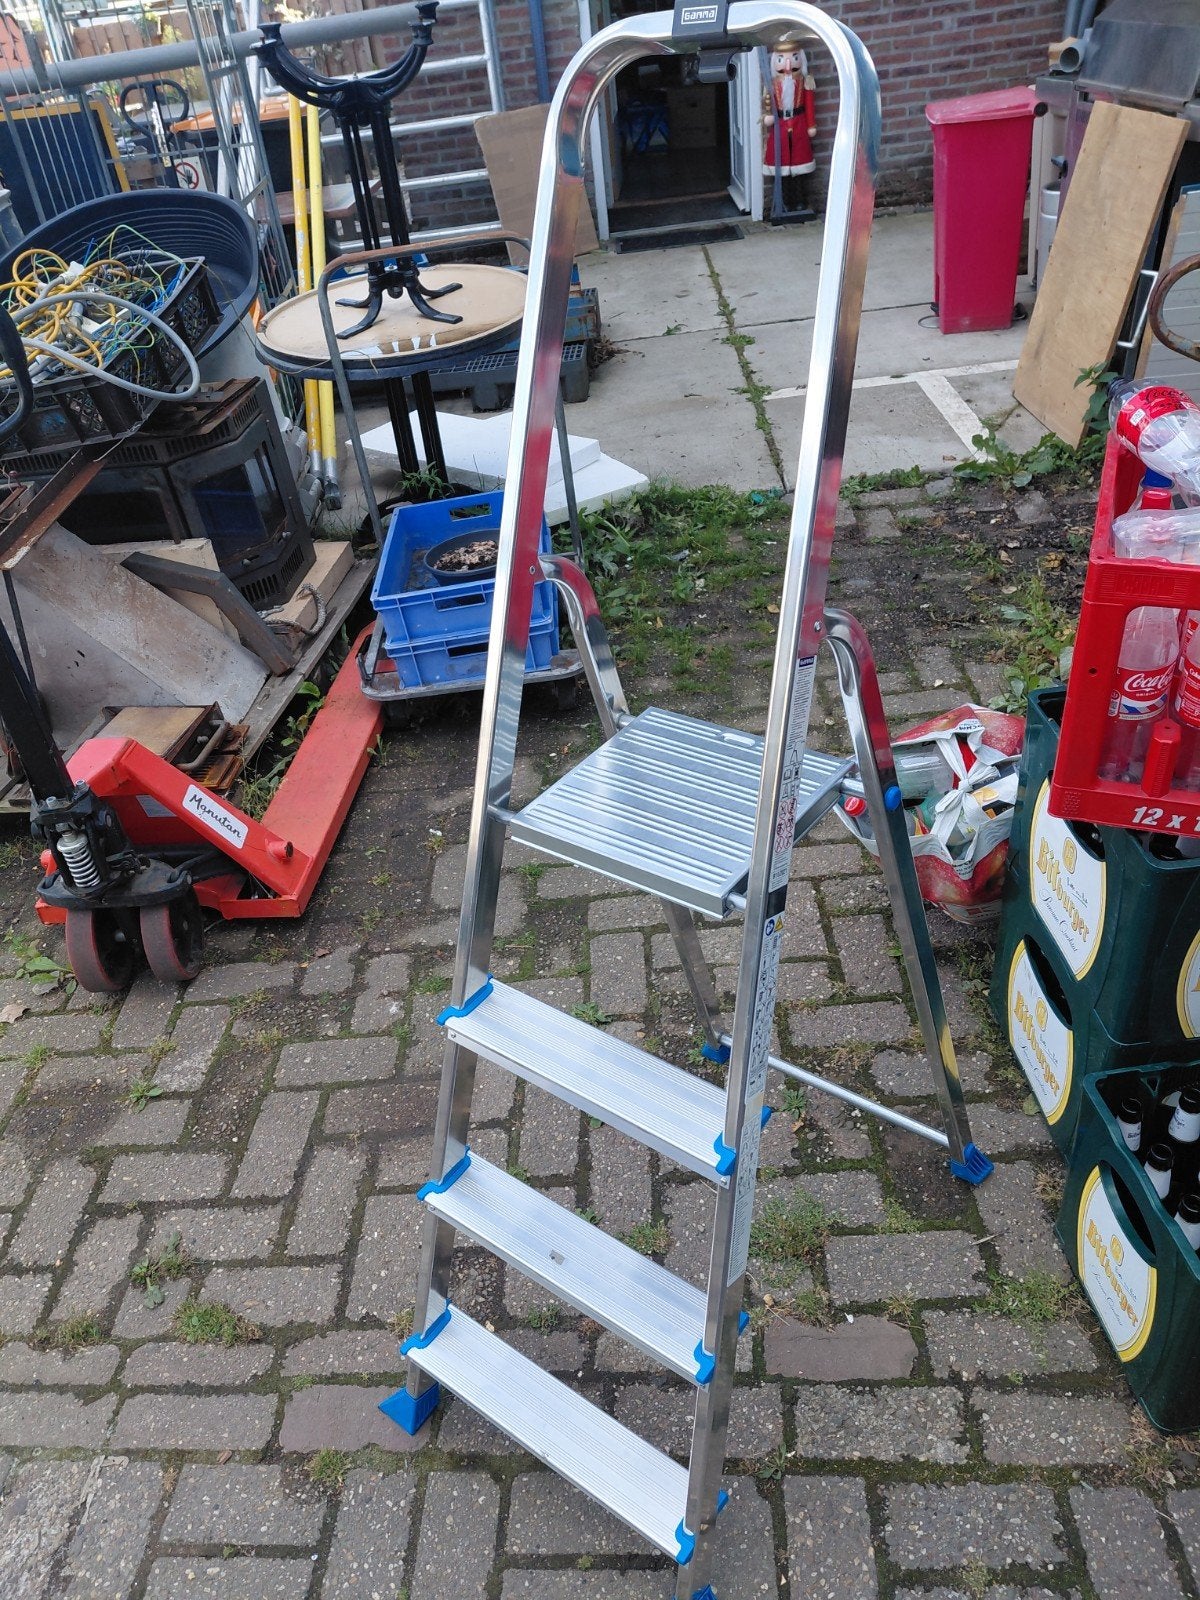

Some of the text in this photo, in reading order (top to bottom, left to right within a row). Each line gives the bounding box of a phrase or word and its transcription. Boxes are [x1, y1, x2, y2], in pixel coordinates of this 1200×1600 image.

[189, 794, 242, 838] Manutan
[1132, 806, 1164, 826] 12
[1165, 814, 1187, 829] x
[1036, 837, 1090, 942] Bitburger
[1014, 990, 1060, 1097] Bitburger
[1086, 1218, 1138, 1327] Bitburger
